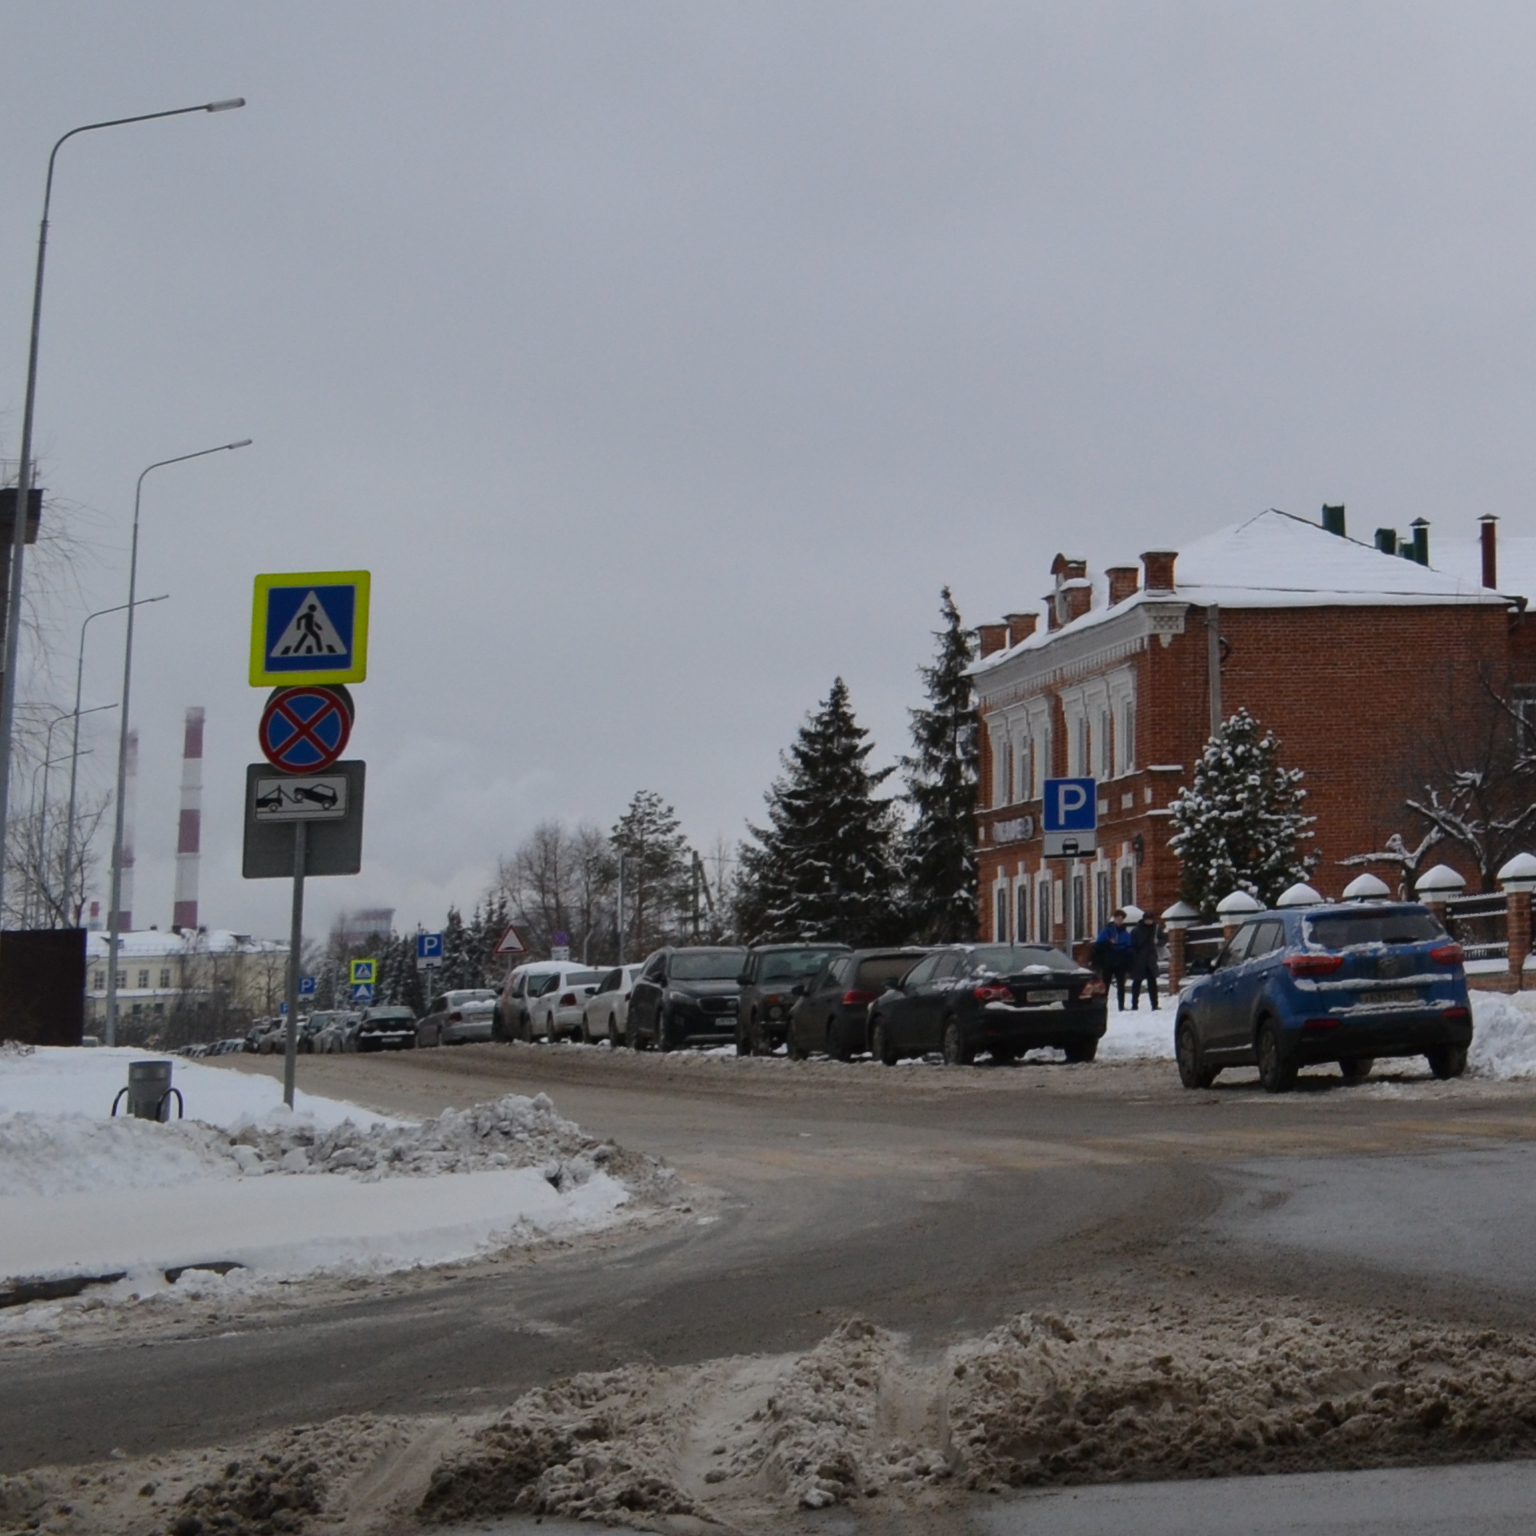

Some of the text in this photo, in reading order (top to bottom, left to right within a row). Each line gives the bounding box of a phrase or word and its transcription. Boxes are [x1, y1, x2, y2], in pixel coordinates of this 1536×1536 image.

[1058, 784, 1087, 825] P
[424, 936, 438, 955] P
[300, 978, 312, 992] P
